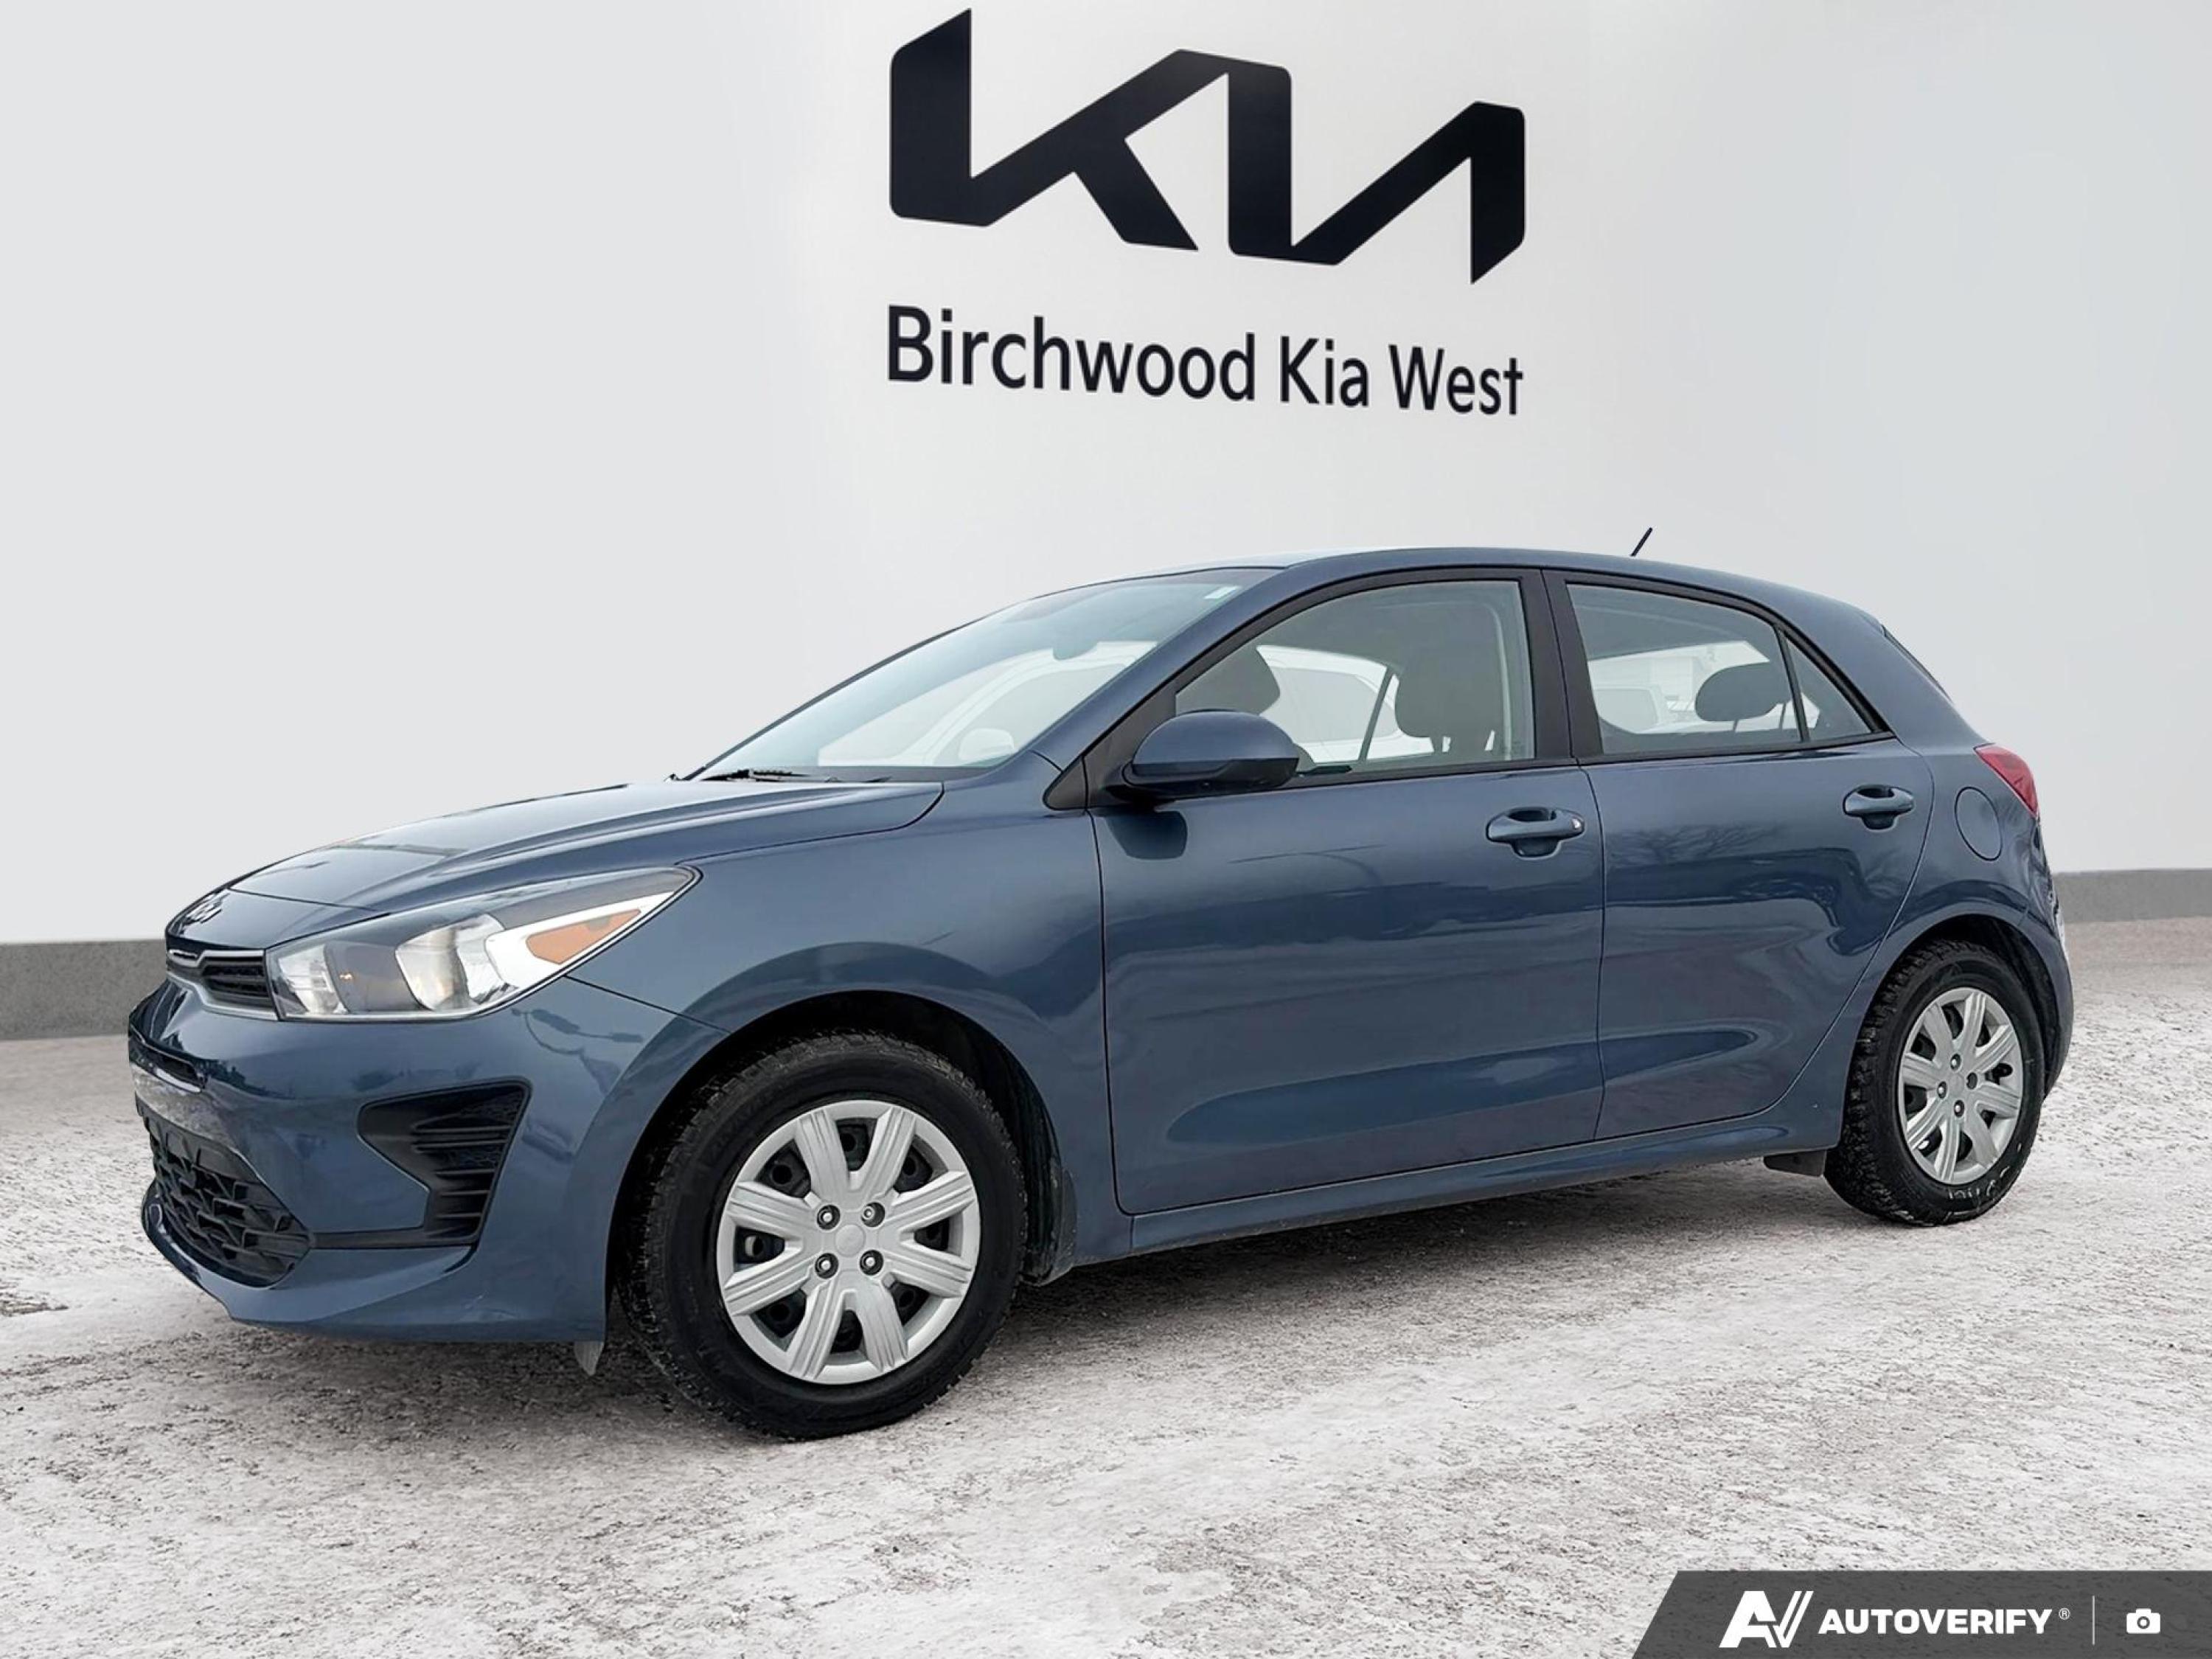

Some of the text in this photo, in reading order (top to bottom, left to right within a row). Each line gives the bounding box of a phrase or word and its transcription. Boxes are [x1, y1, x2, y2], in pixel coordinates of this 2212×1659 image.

[890, 8, 1526, 285] KIA
[888, 304, 1524, 416] Birchwood Kia West
